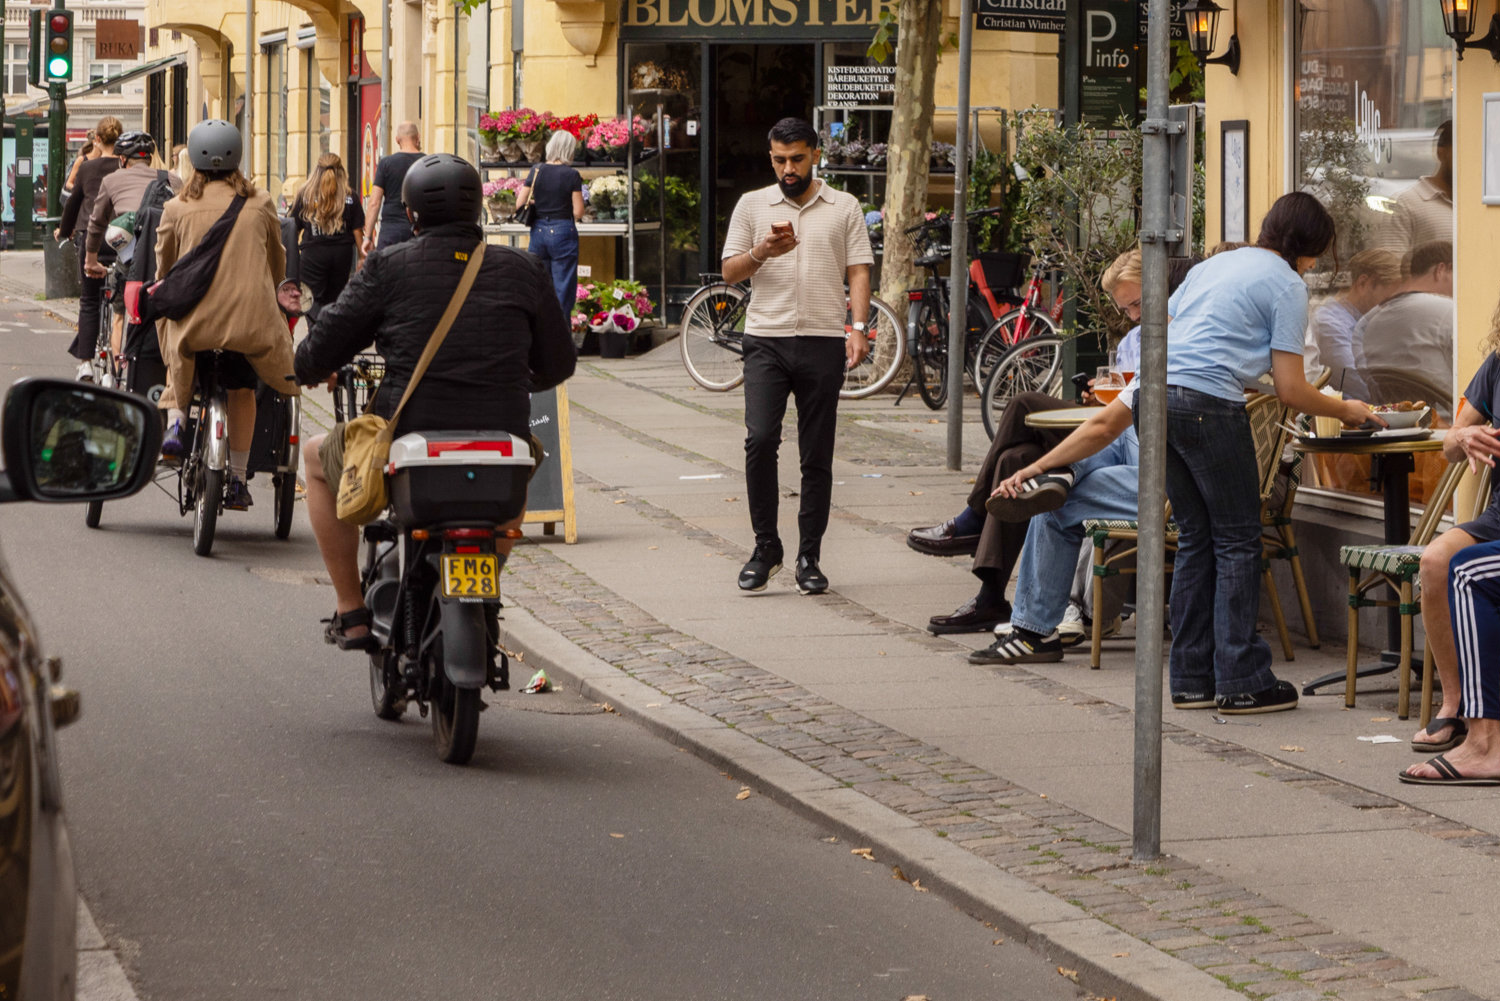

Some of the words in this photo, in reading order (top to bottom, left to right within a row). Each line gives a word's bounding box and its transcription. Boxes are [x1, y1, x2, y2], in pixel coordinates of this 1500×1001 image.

[983, 16, 1026, 29] Christian
[99, 42, 134, 56] BUKA
[1096, 48, 1130, 68] info
[828, 66, 897, 74] KISTEDEKORATIO
[828, 92, 879, 100] DEKORATION
[1355, 80, 1381, 164] LAUS
[449, 559, 492, 576] FM6
[450, 577, 493, 594] 228
